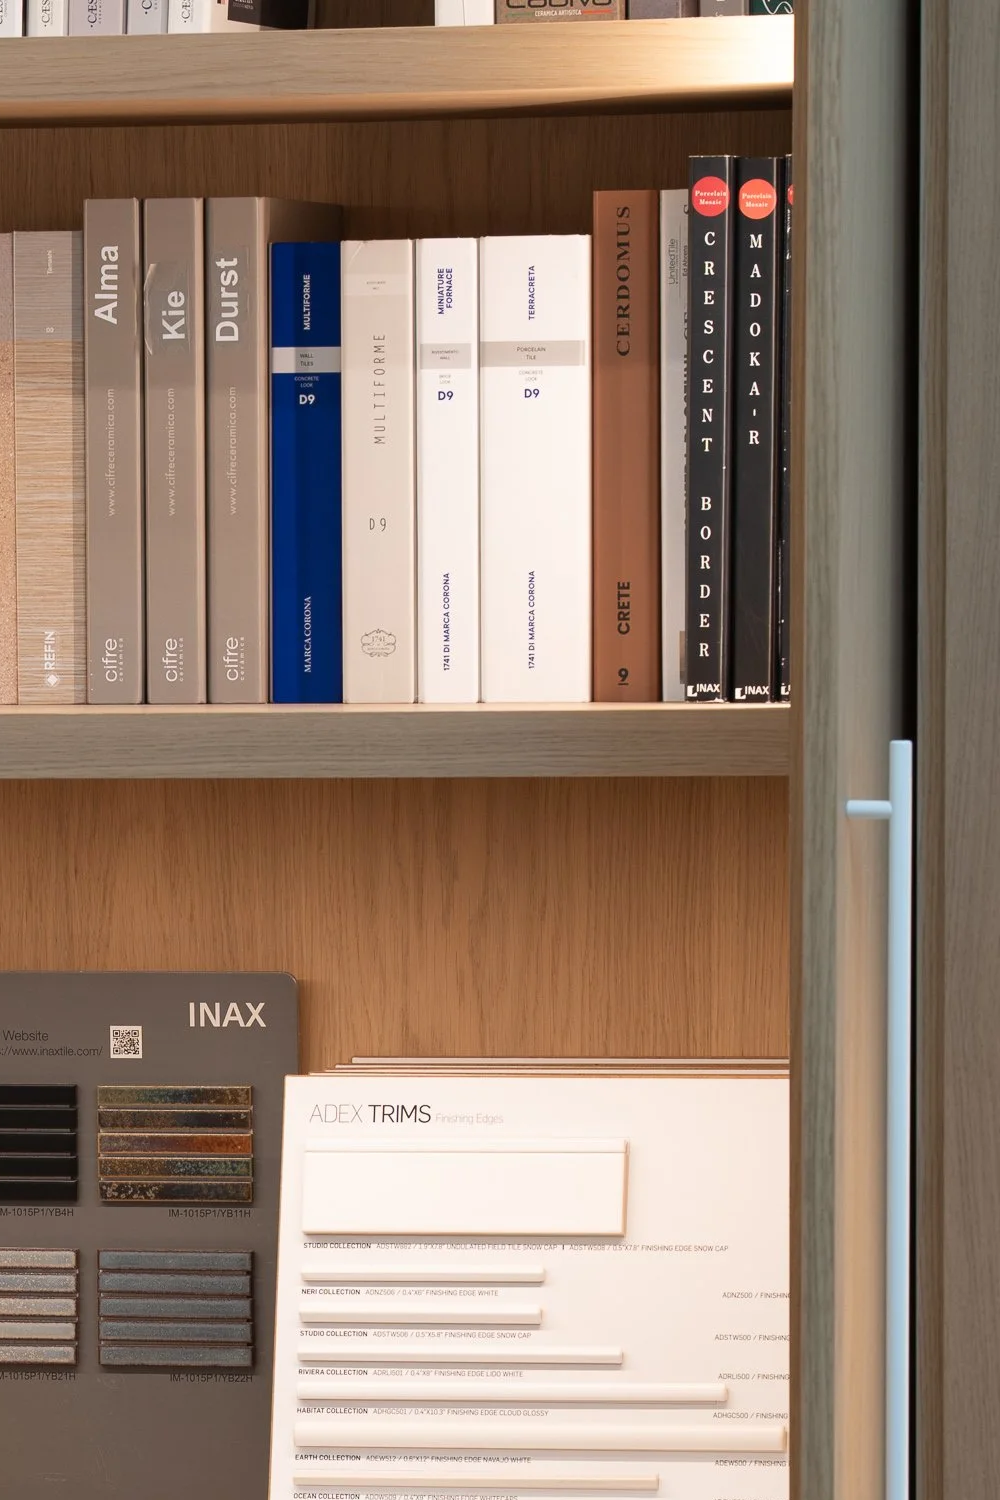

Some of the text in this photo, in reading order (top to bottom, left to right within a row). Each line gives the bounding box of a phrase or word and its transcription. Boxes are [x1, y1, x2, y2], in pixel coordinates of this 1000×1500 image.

[695, 190, 727, 198] Porcelain
[745, 201, 769, 209] Mosaic
[94, 245, 119, 325] Alma
[215, 257, 239, 342] Durst
[303, 274, 311, 331] MULTIFORME
[437, 268, 445, 315] MINIATURE
[617, 206, 631, 357] CERDOMUS
[162, 291, 186, 340] Kie
[701, 231, 716, 453] CRESCENT
[299, 395, 316, 405] D9
[373, 334, 386, 445] MULTIFORME
[438, 391, 454, 401] D9
[525, 389, 540, 399] D9
[107, 388, 115, 517] www.cifreceramica.com
[167, 388, 176, 516] www.cifreceramica.com
[228, 387, 237, 515] www.cifreceramica.com
[699, 496, 713, 657] BORDER
[617, 581, 631, 636] CRETE
[45, 631, 56, 671] REFIN
[304, 597, 312, 673] MARCA CORONA
[443, 644, 450, 653] DI
[528, 642, 535, 651] DI
[618, 668, 630, 683] 9
[2, 1029, 49, 1042] Website
[189, 1002, 267, 1028] INAX
[309, 1104, 505, 1125] ADEX TRIMS Finishing Edges
